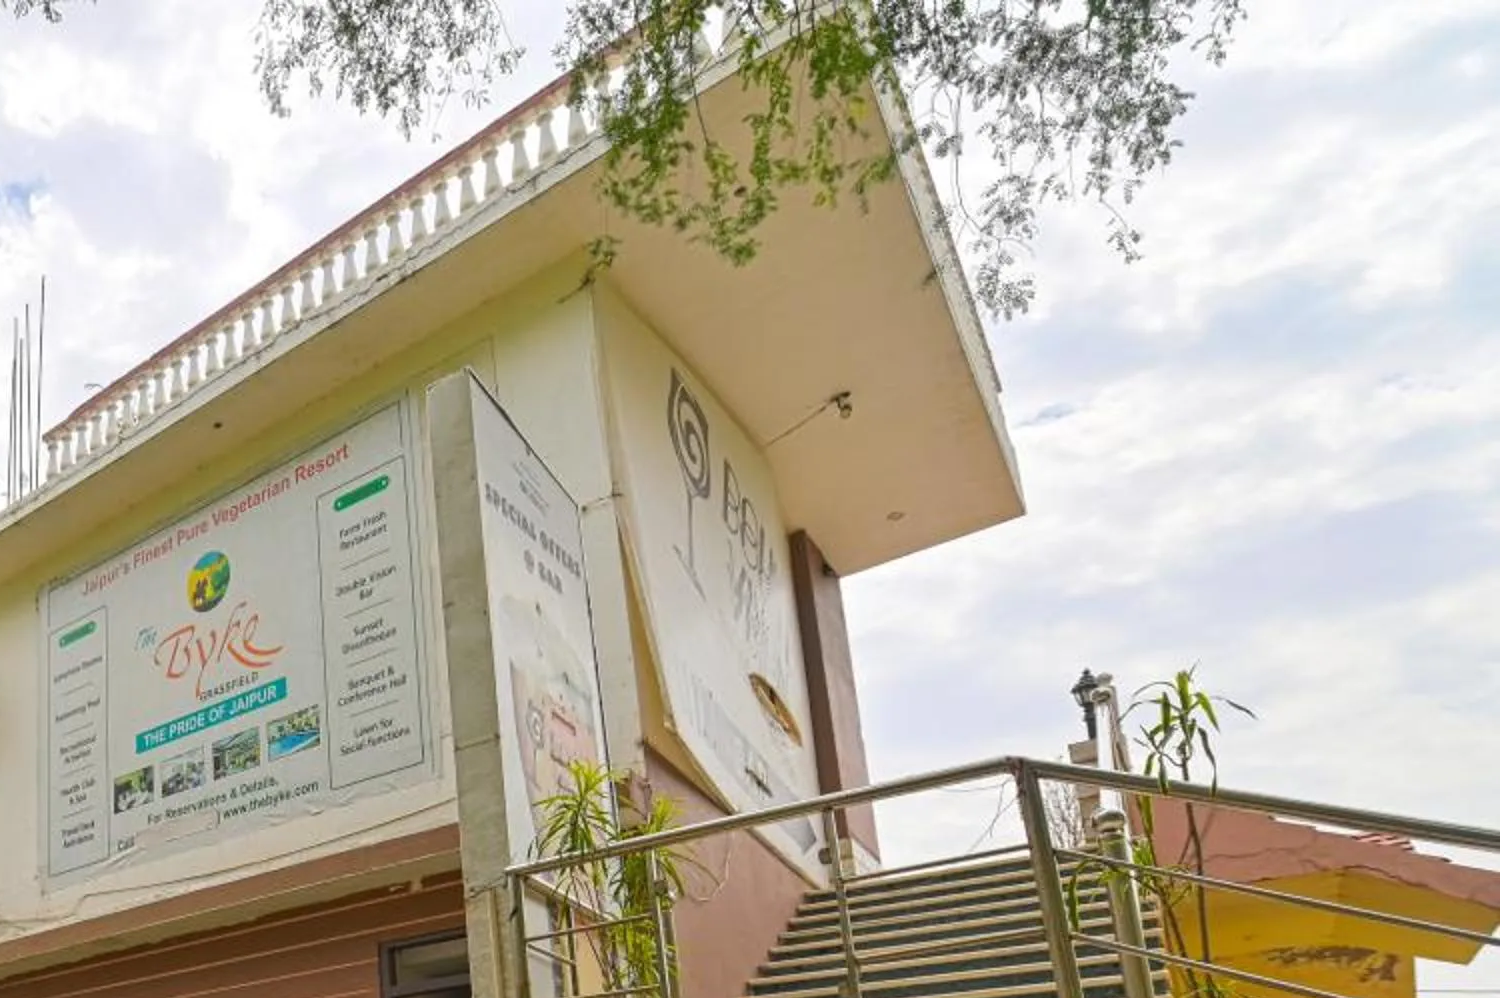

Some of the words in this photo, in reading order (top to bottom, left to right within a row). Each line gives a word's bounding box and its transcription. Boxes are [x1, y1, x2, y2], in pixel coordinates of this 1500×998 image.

[82, 560, 131, 596] Jaipur's
[133, 537, 174, 570] Finest
[176, 519, 208, 547] Pure
[211, 475, 291, 527] Vegetarian
[294, 443, 349, 485] Resort
[199, 671, 260, 701] GRASSFIELD
[143, 730, 166, 748] THE
[169, 713, 206, 739] PRIDE
[208, 704, 226, 722] OF
[228, 684, 278, 716] JAIPUR
[165, 792, 227, 819] Reservations
[222, 780, 320, 820] www.thebyke.com
